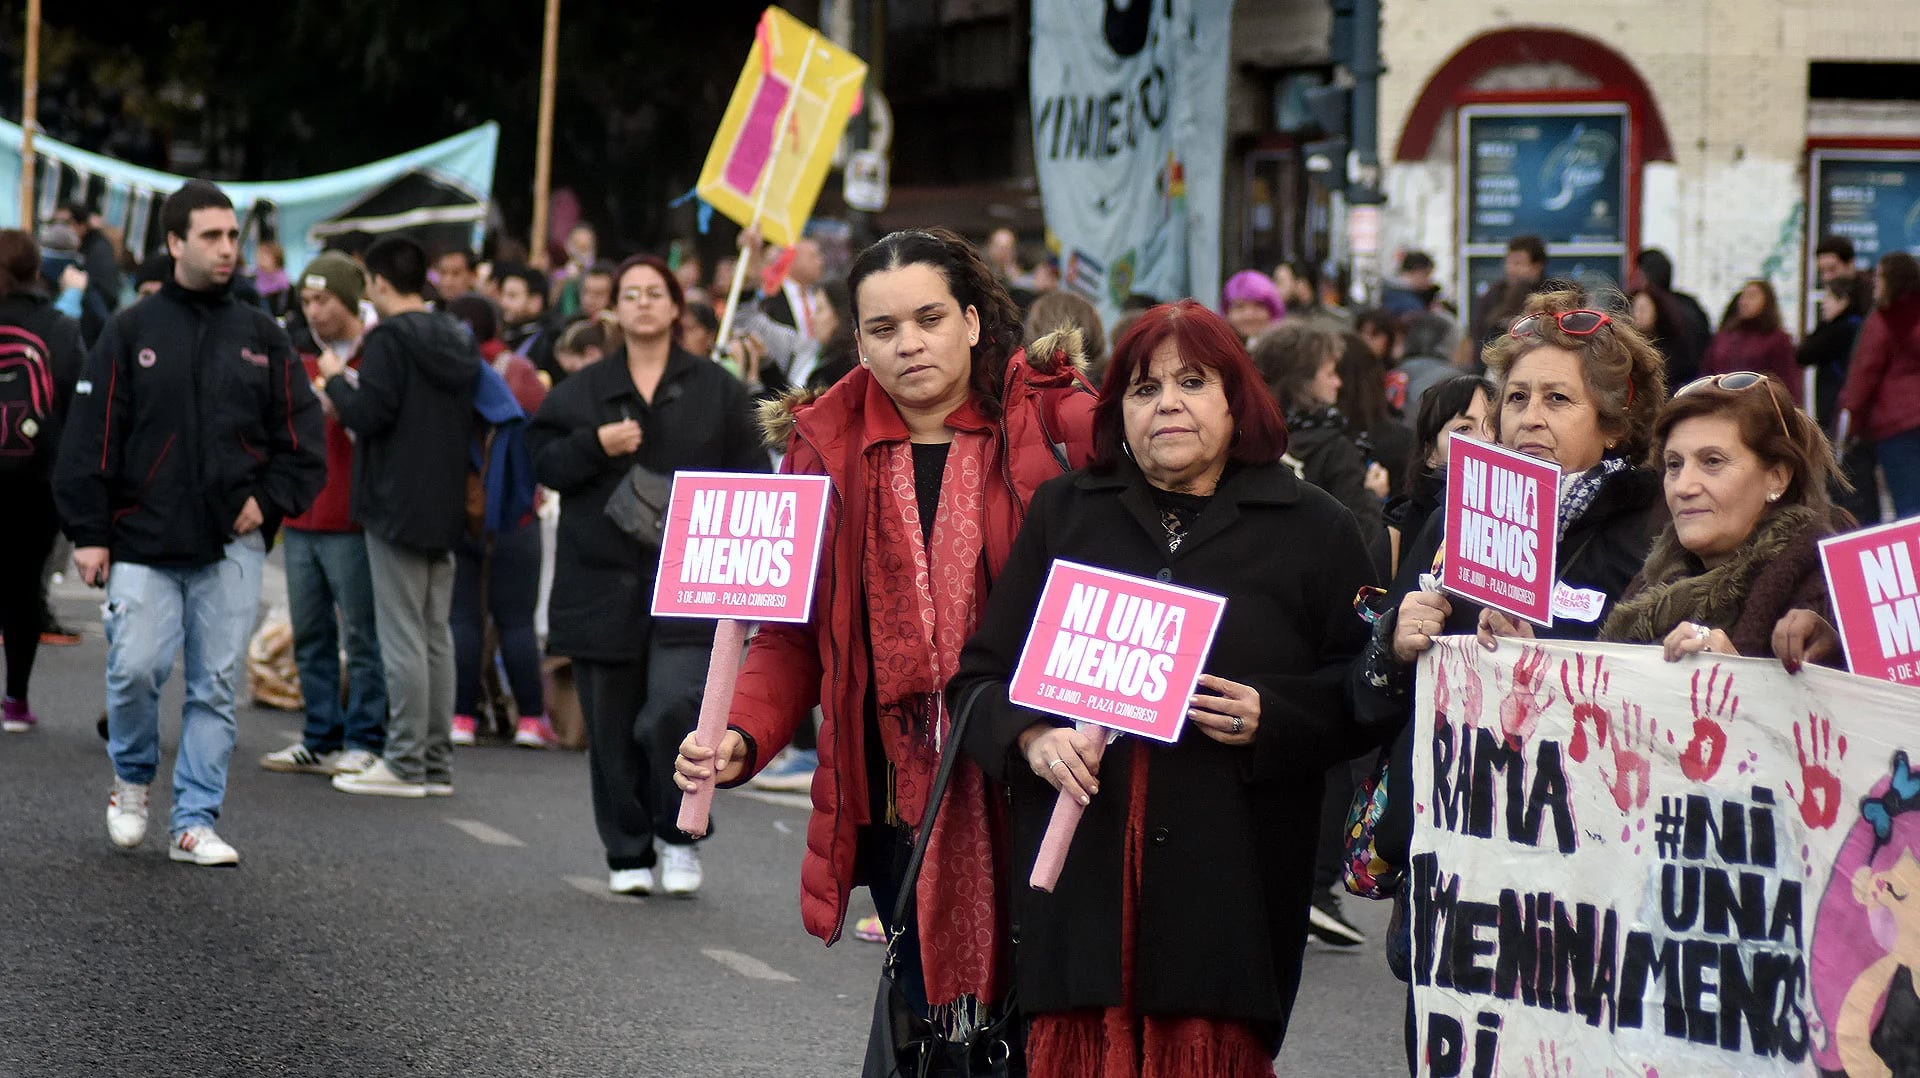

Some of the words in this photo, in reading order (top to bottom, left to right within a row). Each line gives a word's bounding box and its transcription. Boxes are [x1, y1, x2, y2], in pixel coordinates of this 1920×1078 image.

[688, 489, 727, 535] NI
[728, 490, 796, 538] UNA
[1462, 455, 1487, 511] NI
[1490, 465, 1538, 530] UNA
[680, 537, 794, 588] MENOS
[1459, 508, 1538, 583] MENOS
[1858, 541, 1918, 604] NI
[676, 590, 683, 603] 3
[683, 591, 694, 603] DE
[694, 591, 716, 604] JUNIO
[722, 592, 746, 606] PLAZA
[747, 593, 787, 607] CONGRESO
[1060, 582, 1109, 635] NI
[1106, 593, 1186, 655] UNA
[1555, 594, 1591, 609] MENOS
[1558, 587, 1569, 598] NI
[1570, 592, 1590, 601] UNA
[1043, 630, 1175, 703] MENOS
[1888, 667, 1897, 682] 3
[1897, 663, 1913, 680] DE
[1037, 682, 1045, 696] 3
[1044, 684, 1057, 699] DE
[1056, 688, 1082, 705] JUNIO
[1087, 695, 1114, 713] PLAZA
[1114, 701, 1158, 723] CONGRESO
[1433, 711, 1577, 854] RAMA
[1661, 863, 1803, 950] UNA
[1617, 930, 1809, 1064] MENOS
